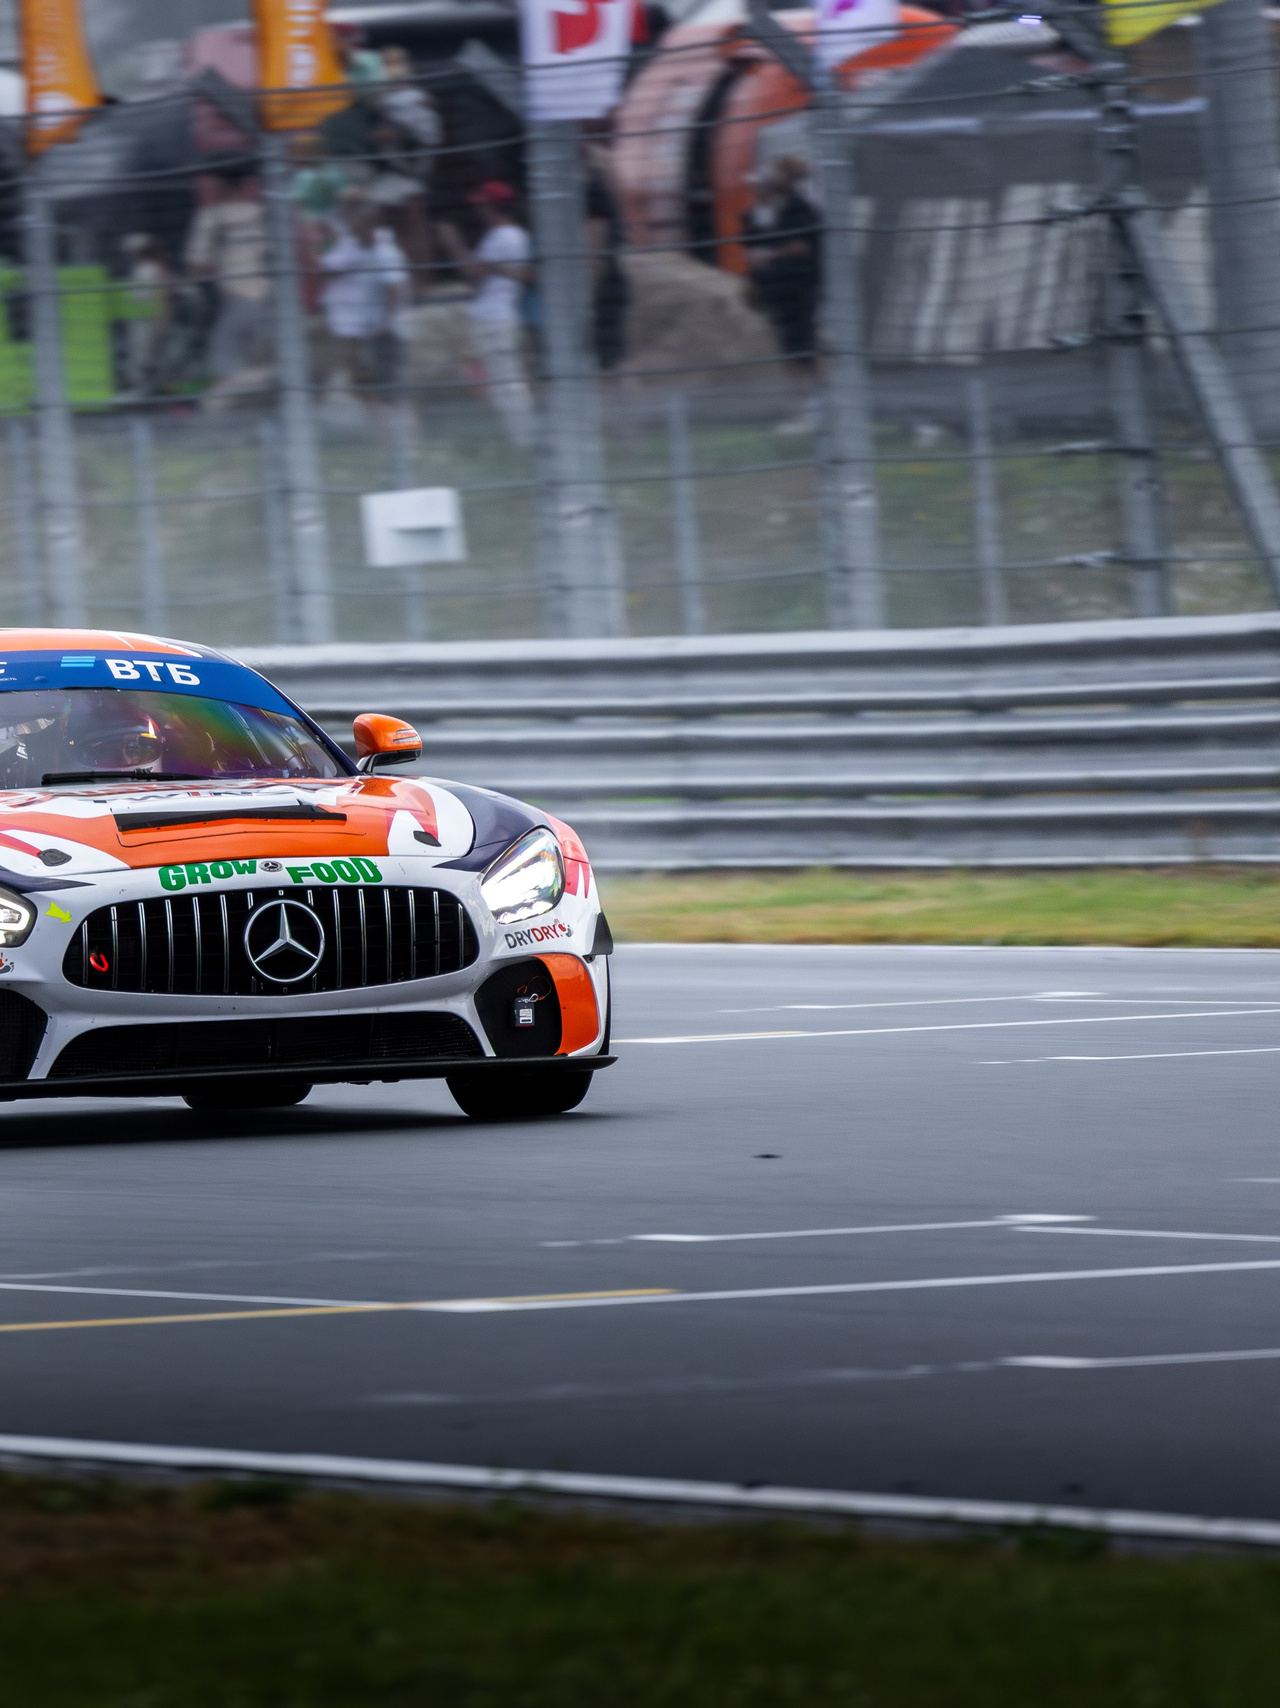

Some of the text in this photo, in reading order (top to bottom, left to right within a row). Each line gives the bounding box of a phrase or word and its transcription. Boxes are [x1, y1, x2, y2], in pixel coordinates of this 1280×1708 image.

[105, 659, 200, 685] ВТБ
[158, 858, 383, 891] GROW FOOD
